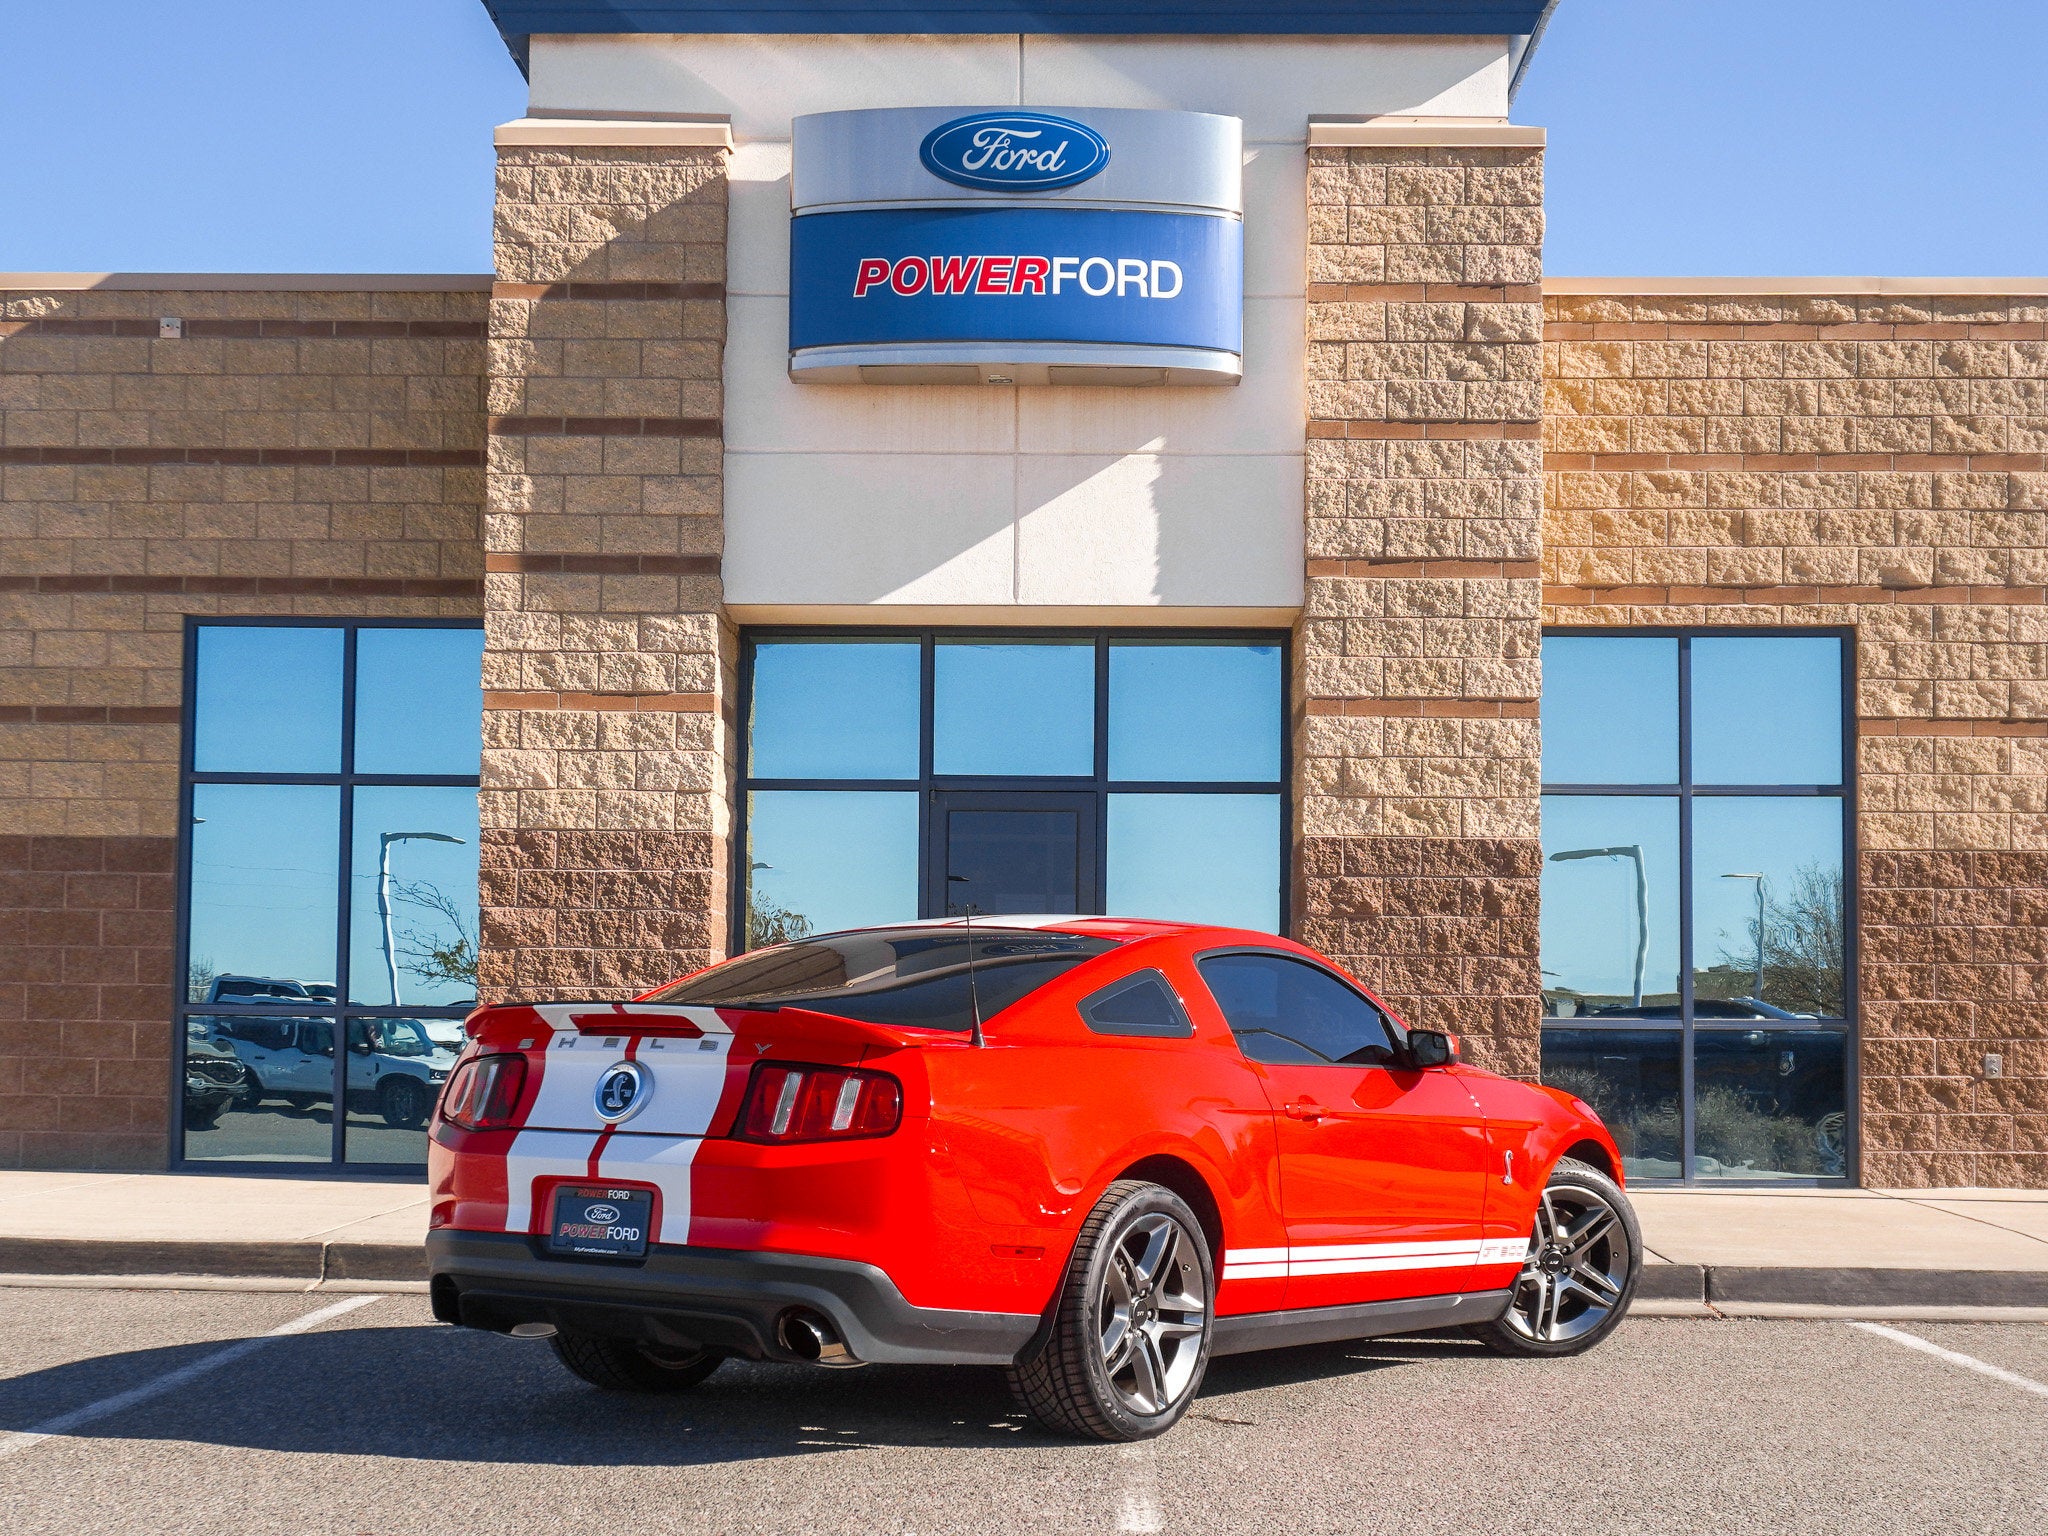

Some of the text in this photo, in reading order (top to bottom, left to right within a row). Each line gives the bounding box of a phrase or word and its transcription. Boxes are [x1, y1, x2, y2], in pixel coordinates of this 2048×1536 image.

[961, 127, 1069, 173] Ford
[853, 255, 1183, 299] POWERFORD
[517, 1037, 773, 1055] SHELBY
[577, 1188, 630, 1200] POWERFORD
[590, 1207, 614, 1221] Ford
[559, 1222, 640, 1241] POWERFORD
